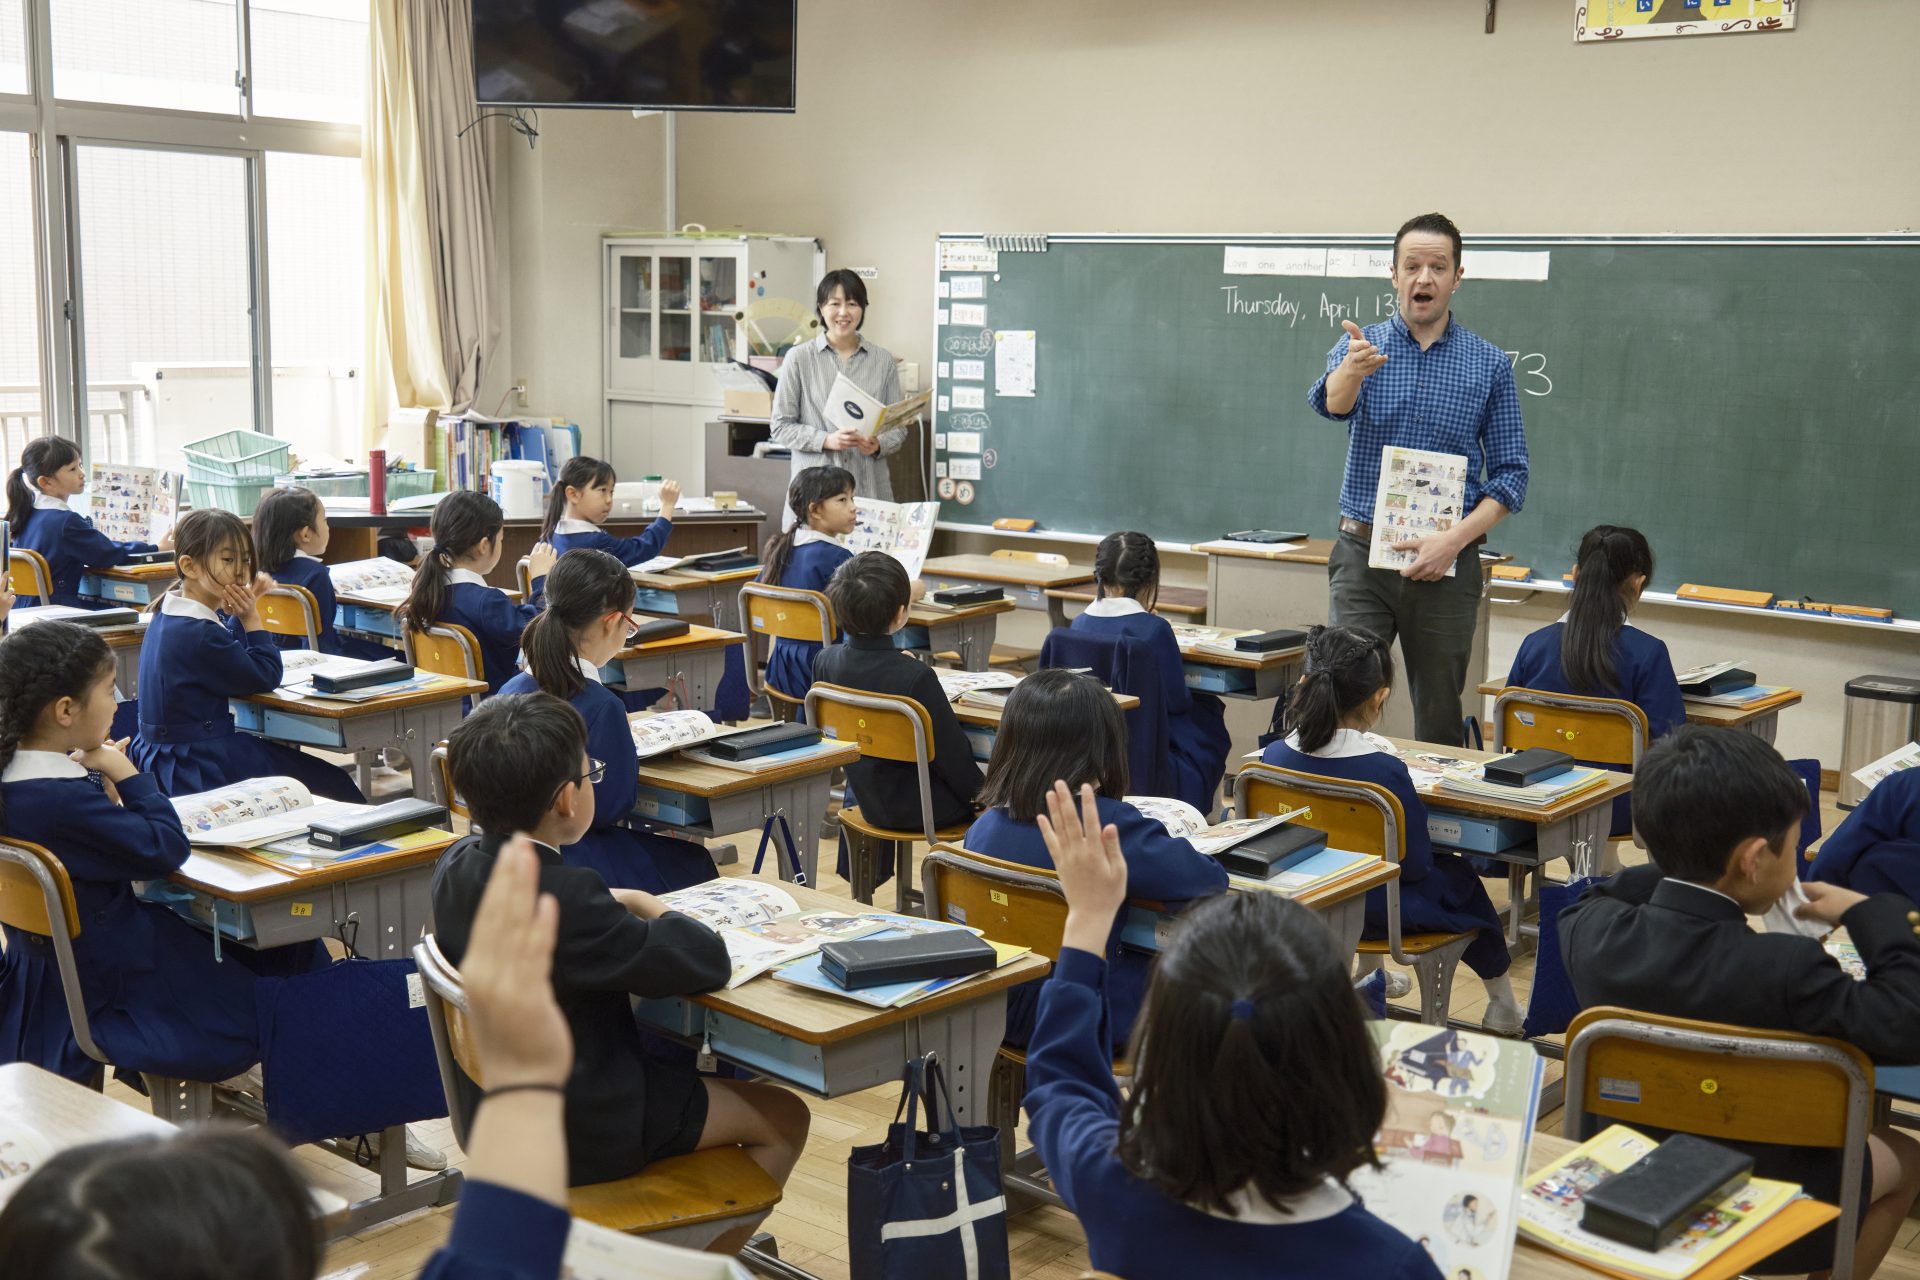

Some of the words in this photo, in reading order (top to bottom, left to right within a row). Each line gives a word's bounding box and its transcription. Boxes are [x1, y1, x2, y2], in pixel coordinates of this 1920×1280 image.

[1226, 256, 1248, 269] Love
[1257, 261, 1276, 271] one
[1285, 259, 1325, 273] another
[1352, 255, 1357, 267] I
[1220, 285, 1306, 329] Thursday,
[1319, 292, 1359, 328] April
[1376, 293, 1400, 317] 13t
[993, 891, 1001, 901] 3B
